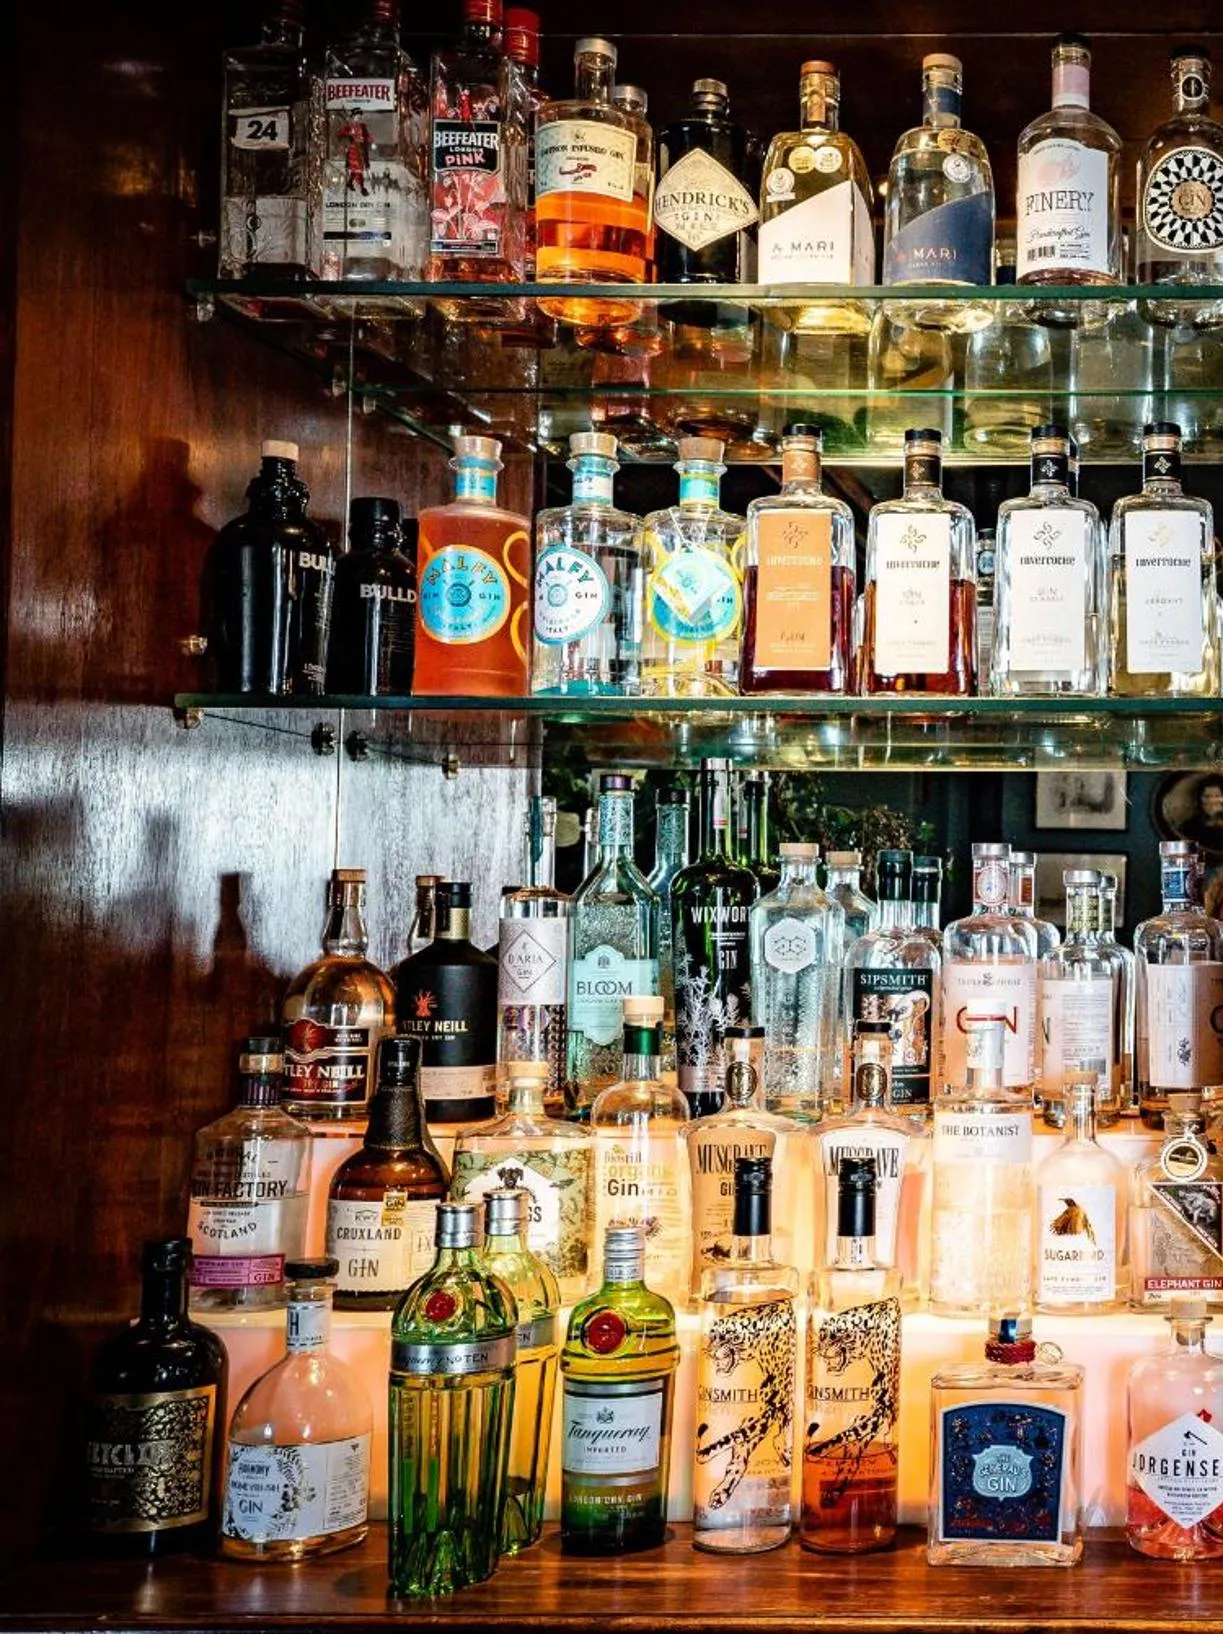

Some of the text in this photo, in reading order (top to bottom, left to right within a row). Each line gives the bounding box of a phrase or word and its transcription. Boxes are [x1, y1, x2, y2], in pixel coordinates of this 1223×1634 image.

[327, 84, 391, 99] BEEFEATER
[247, 120, 278, 142] 24
[433, 130, 500, 150] BEEFEATER
[655, 190, 750, 214] HENDRICK'S
[1026, 190, 1095, 216] FINERY
[682, 213, 713, 222] GIN
[791, 240, 835, 252] MARI
[913, 247, 958, 260] MARI
[691, 906, 752, 925] WIXWORT
[718, 950, 738, 970] GIN
[859, 973, 928, 986] SIPSMITH
[576, 980, 633, 996] BLOOM
[402, 1020, 469, 1032] TLEY NEILL
[284, 1063, 366, 1079] TLEY NEILL
[892, 1088, 913, 1099] GIN
[941, 1123, 1020, 1137] THE BOTANIST
[214, 1180, 288, 1198] FACTORY
[607, 1178, 639, 1196] Gin
[197, 1220, 257, 1239] SCOTLAND
[336, 1227, 402, 1241] CRUXLAND
[1044, 1248, 1105, 1261] SUGARD
[348, 1259, 380, 1278] GIN
[253, 1272, 277, 1282] GIN
[1147, 1278, 1223, 1290] ELEPHANT GIN
[462, 1352, 488, 1364] TEN
[699, 1386, 758, 1402] INSMITH
[808, 1385, 871, 1401] INSMITH
[567, 1420, 651, 1442] Tanqueray
[977, 1462, 1028, 1477] GENERAL'S
[987, 1477, 1017, 1493] GIN
[238, 1500, 264, 1514] GIN
